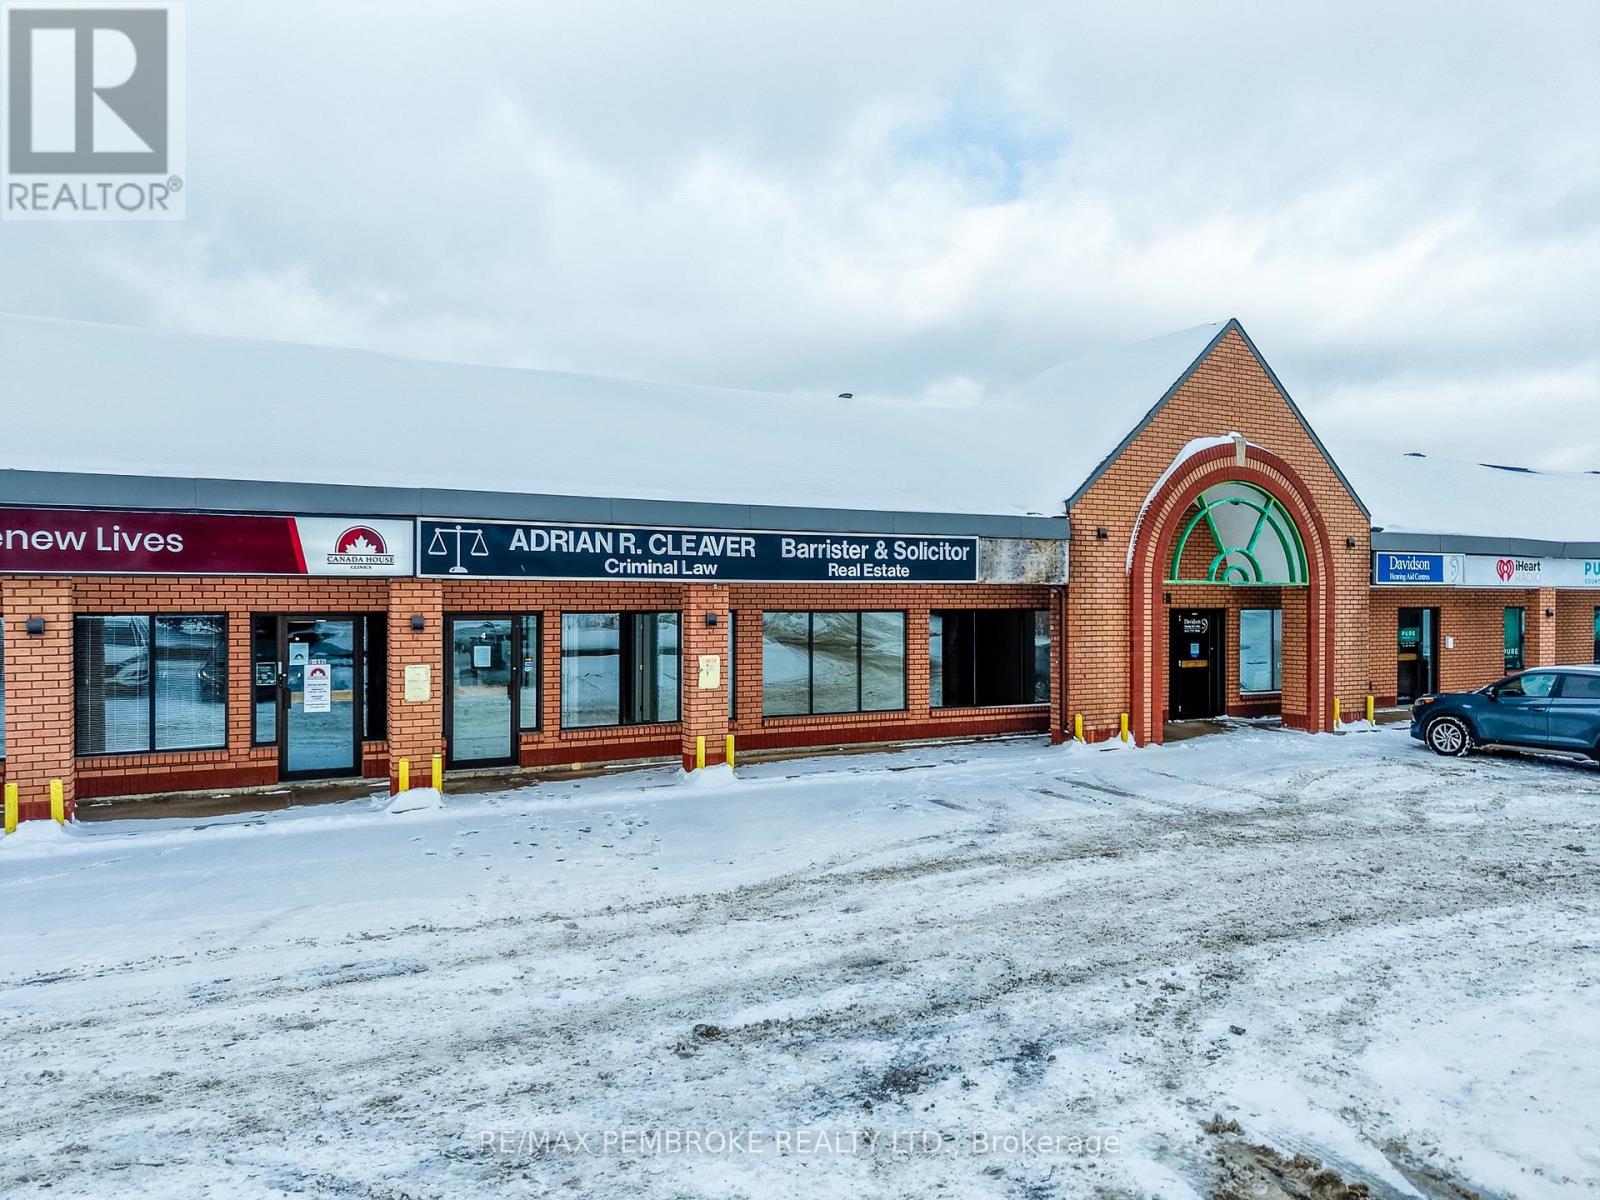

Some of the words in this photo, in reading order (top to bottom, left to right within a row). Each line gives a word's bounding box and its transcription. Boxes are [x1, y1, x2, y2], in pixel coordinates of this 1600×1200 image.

[97, 525, 184, 553] Lives
[509, 528, 613, 554] ADRIAN
[619, 532, 642, 555] R.
[648, 533, 756, 558] CLEAVER
[781, 537, 869, 560] Barrister
[874, 540, 889, 560] &
[893, 541, 970, 561] Solicitor
[604, 558, 678, 575] Criminal
[681, 560, 718, 575] Law
[828, 562, 861, 577] Real
[863, 563, 910, 577] Estate
[1389, 555, 1430, 570] Davidson
[1515, 559, 1541, 571] iHeart
